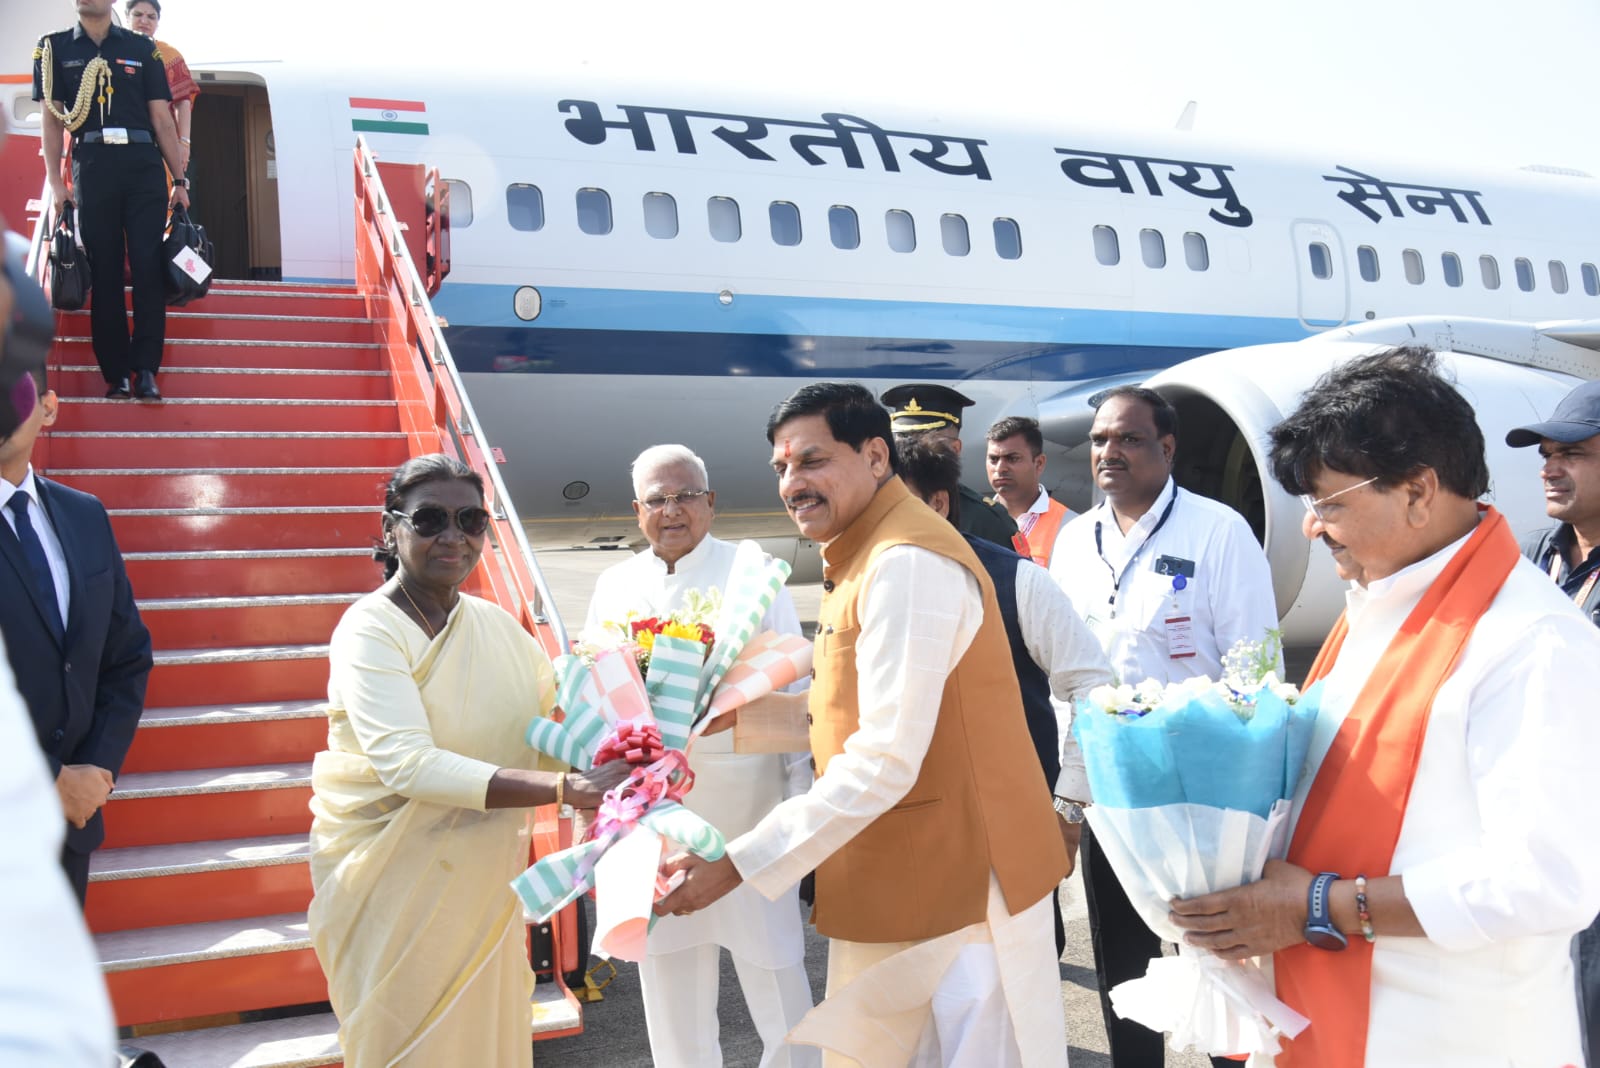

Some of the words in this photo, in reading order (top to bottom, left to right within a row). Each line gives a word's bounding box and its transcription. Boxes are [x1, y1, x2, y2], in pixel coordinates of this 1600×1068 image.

[557, 99, 992, 181] भारतीय
[1054, 147, 1253, 228] वायु
[1322, 165, 1492, 226] सेना
